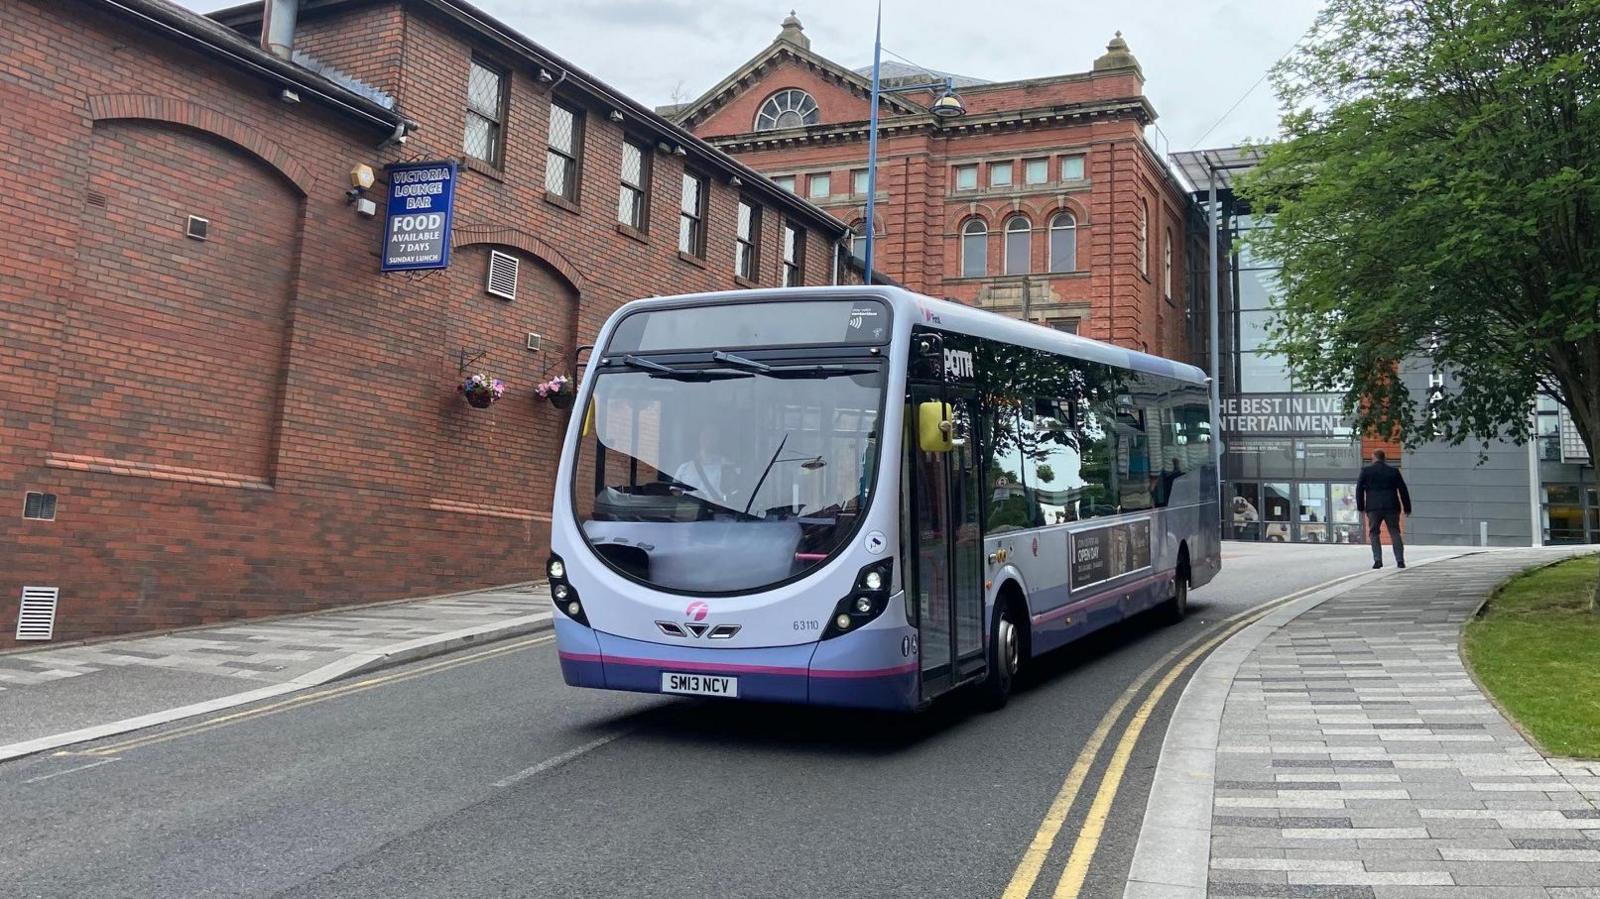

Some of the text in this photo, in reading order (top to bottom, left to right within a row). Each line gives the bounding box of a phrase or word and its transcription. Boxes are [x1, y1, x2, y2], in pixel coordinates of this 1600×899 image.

[393, 168, 450, 184] VICTORIA
[394, 182, 443, 197] LOUNGE
[406, 196, 432, 209] BAR
[393, 214, 441, 232] FOOD
[392, 232, 440, 242] AVAILABLE
[399, 242, 430, 252] 7 DAYS
[415, 254, 438, 263] LUNCH
[1218, 397, 1343, 414] HE BEST IN LIVE
[1218, 415, 1345, 432] NTERTAINMENT
[792, 620, 819, 631] 63110
[670, 675, 729, 693] SM13 NCV
